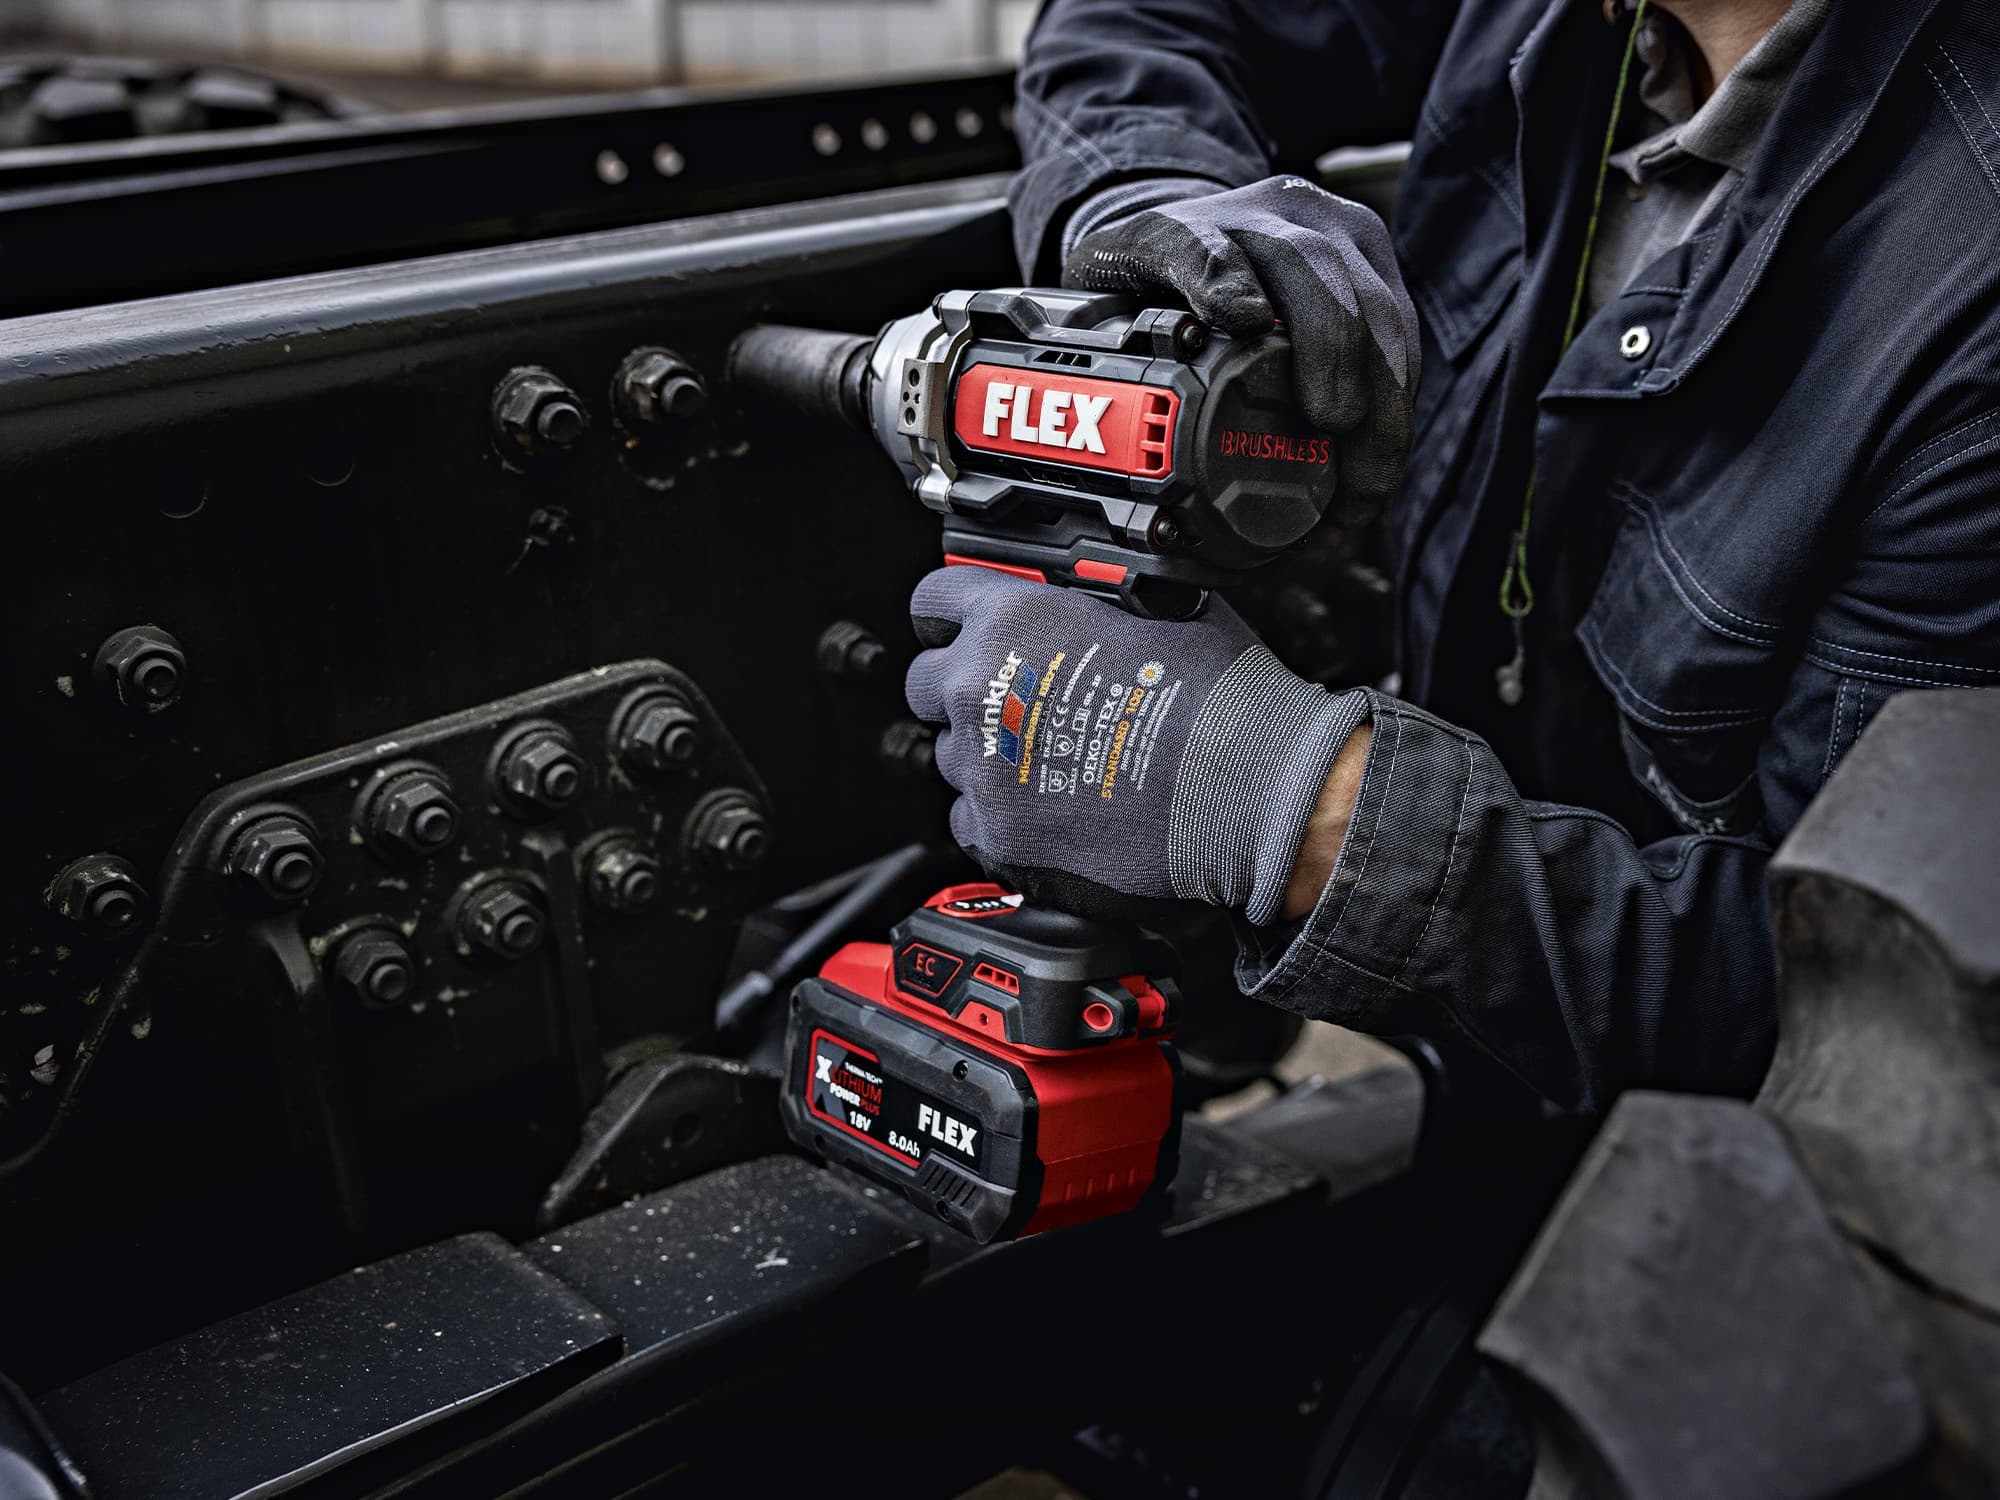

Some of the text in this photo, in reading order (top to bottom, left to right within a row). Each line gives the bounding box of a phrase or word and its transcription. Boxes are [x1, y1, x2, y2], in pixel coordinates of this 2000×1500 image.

[982, 382, 1113, 454] FLEX
[1221, 430, 1330, 466] BRUSHLESS
[982, 651, 1023, 758] winkler
[1018, 701, 1042, 783] Microfoam
[1083, 698, 1116, 782] OEKO-TEX
[1102, 687, 1146, 797] STANDARD 100
[915, 952, 936, 976] EC
[849, 1111, 871, 1132] 18V
[888, 1131, 920, 1158] 8.0Ah
[918, 1104, 977, 1157] FLEX
